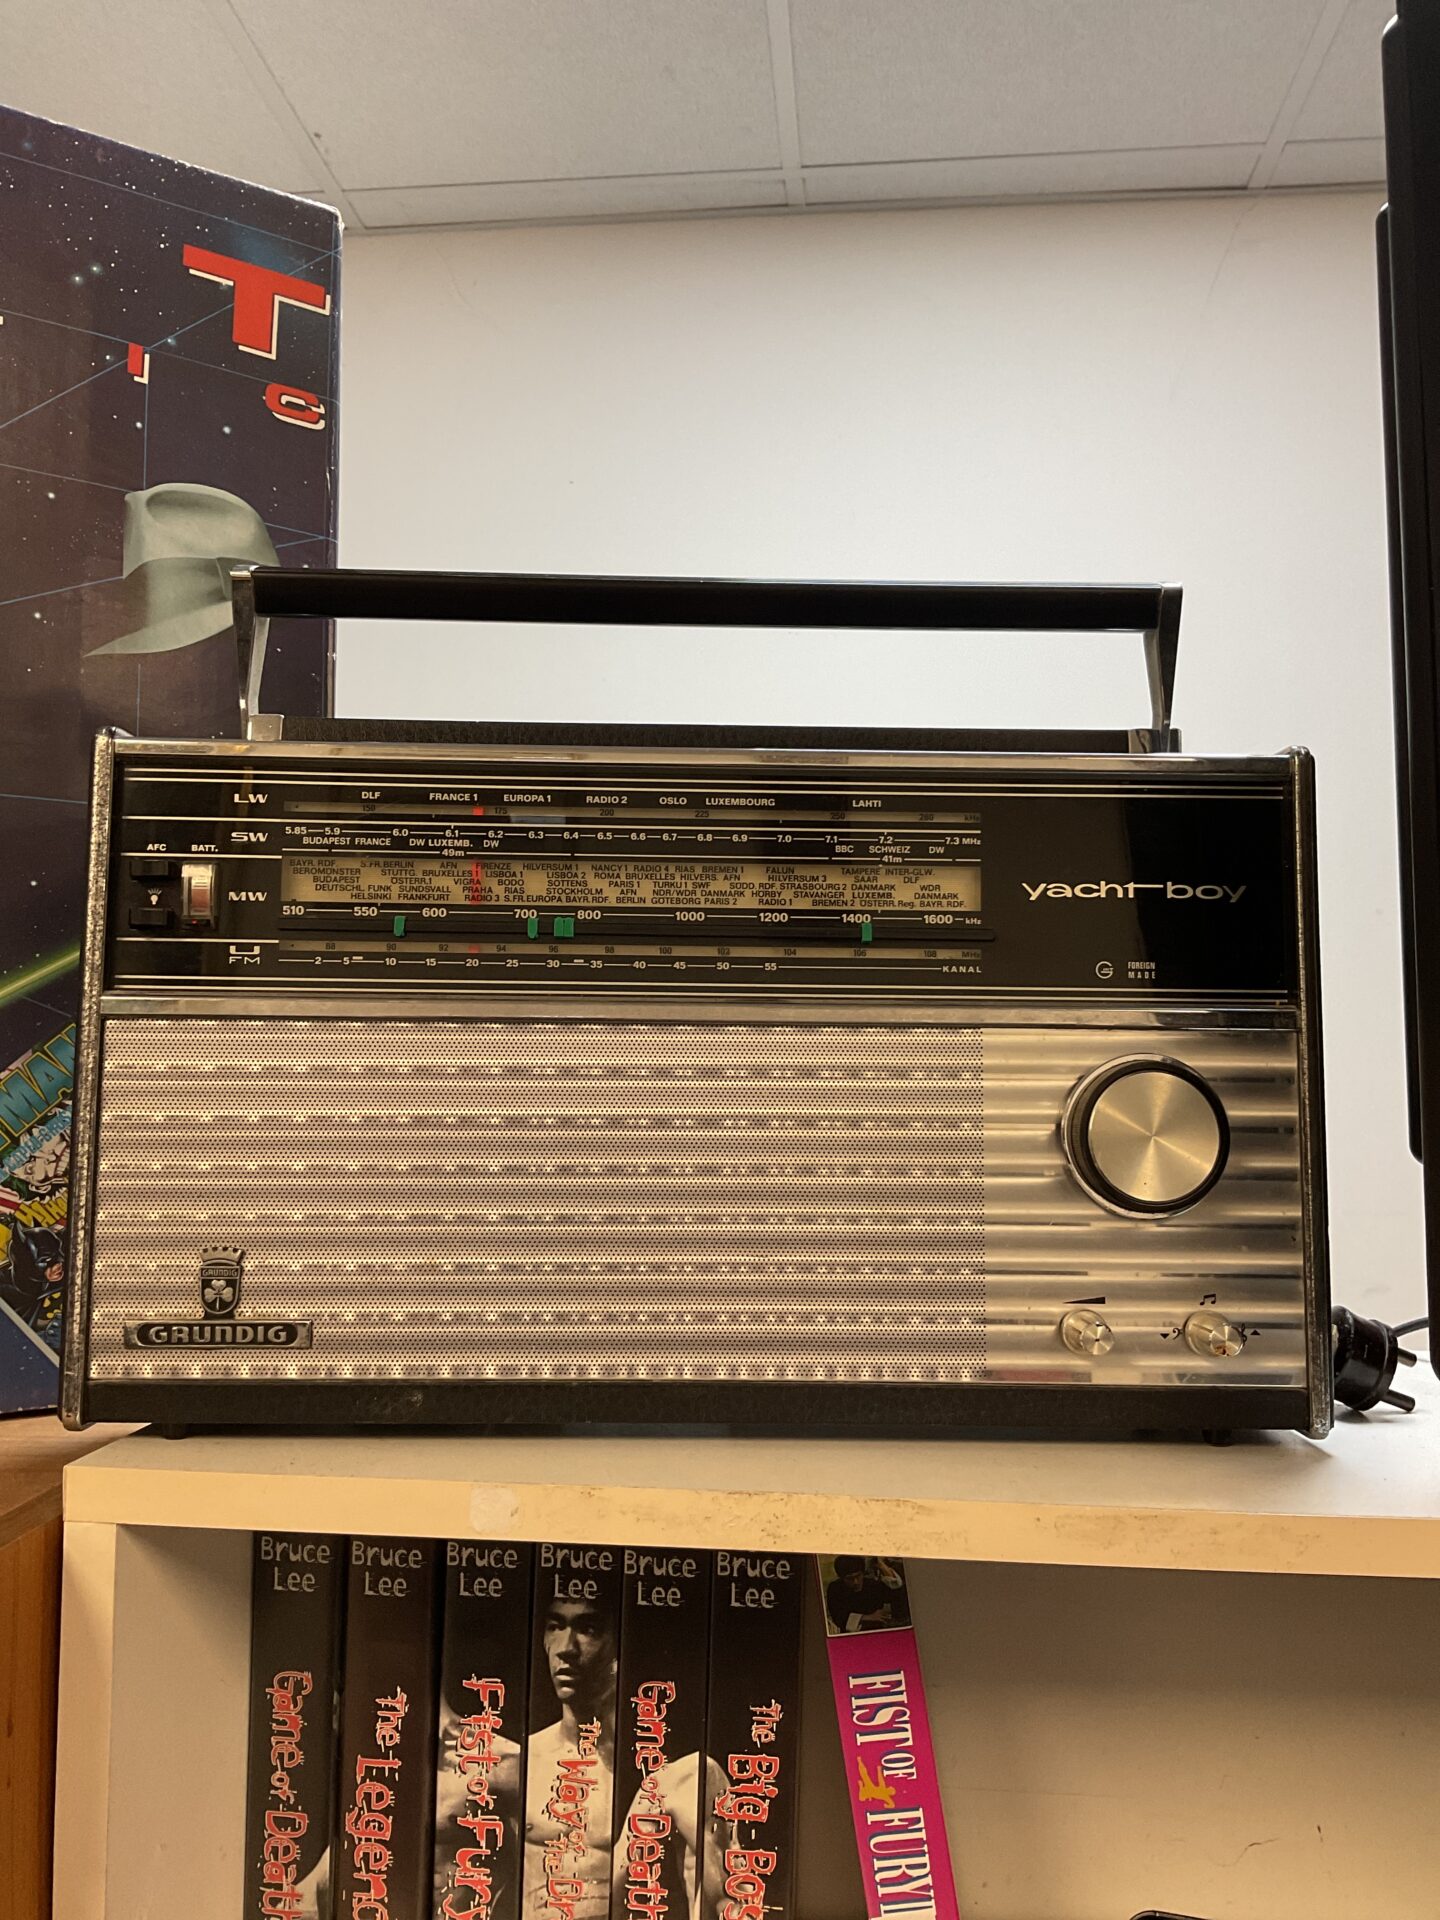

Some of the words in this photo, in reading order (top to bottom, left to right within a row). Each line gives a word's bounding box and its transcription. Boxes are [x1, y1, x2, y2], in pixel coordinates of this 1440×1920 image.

[234, 794, 268, 803] LW
[429, 793, 470, 801] FRANCE
[503, 794, 544, 802] EUROPA
[659, 797, 687, 805] OSLO
[705, 798, 775, 806] LUXEMBOURG
[231, 832, 268, 842] SW
[285, 827, 307, 835] 5.85
[325, 827, 340, 835] 5.9
[488, 830, 503, 838] 6.2
[528, 831, 544, 839] 6.3
[563, 832, 579, 840] 6.4
[597, 832, 613, 840] 6.5
[662, 833, 677, 841] 6.7
[732, 834, 748, 842] 6.9
[777, 835, 792, 843] 7.0
[879, 836, 893, 844] 7.2
[945, 837, 960, 845] 7.3
[303, 837, 351, 845] BUDAPEST
[355, 838, 391, 846] FRANCE
[428, 839, 473, 847] LUXEMB.
[483, 840, 499, 848] DW
[835, 845, 854, 853] BBC
[868, 845, 911, 854] SCHWEIZ
[928, 846, 945, 854] DW
[442, 849, 464, 857] 49m
[523, 863, 572, 871] HILVERSUM
[591, 864, 623, 872] NANCY
[766, 866, 795, 874] FALUN
[594, 872, 621, 880] ROMA
[652, 889, 697, 897] NDR/WDR
[780, 883, 840, 891] STRASBOURG
[1021, 880, 1163, 901] yacht
[1166, 881, 1247, 903] boy
[228, 892, 267, 901] MW
[398, 893, 450, 901] FRANKFURT
[464, 894, 492, 902] RADIO
[616, 896, 646, 904] BERLIN
[812, 899, 848, 907] BREMEN
[282, 905, 304, 915] 510
[353, 907, 378, 916] 550
[422, 908, 447, 917] 600
[514, 909, 537, 918] 700
[577, 910, 601, 920] 800
[675, 911, 705, 921] 1000
[759, 912, 788, 922] 1200
[841, 914, 871, 923] 1400
[923, 914, 953, 924] 1600
[343, 957, 350, 965] 5
[425, 958, 437, 966] 15
[506, 959, 519, 967] 25
[546, 960, 560, 968] 30
[633, 961, 646, 969] 40
[716, 962, 730, 970] 50
[764, 963, 777, 971] 55
[1128, 961, 1156, 970] FOREIGN
[1128, 971, 1156, 979] MADE
[202, 1269, 237, 1277] GRUNDIG
[150, 1326, 287, 1343] GRUNDIG
[260, 1536, 331, 1564] Bruce
[352, 1540, 423, 1569] Bruce
[446, 1541, 519, 1569] Bruce
[540, 1544, 613, 1571] Bruce
[624, 1550, 698, 1579] Bruce
[717, 1551, 791, 1580] Bruce
[274, 1567, 317, 1592] Lee
[364, 1573, 408, 1597] Lee
[459, 1571, 503, 1598] Lee
[554, 1574, 599, 1599] Lee
[637, 1581, 682, 1607] Lee
[730, 1583, 776, 1608] Lee
[848, 1670, 914, 1747] FIST
[266, 1670, 312, 1768] Game
[375, 1686, 407, 1748] The
[630, 1680, 676, 1769] Game
[749, 1699, 783, 1748] The
[458, 1676, 505, 1774] Fist
[578, 1717, 601, 1758] The
[880, 1750, 917, 1781] OF
[548, 1759, 599, 1831] Way
[714, 1754, 780, 1823] Big
